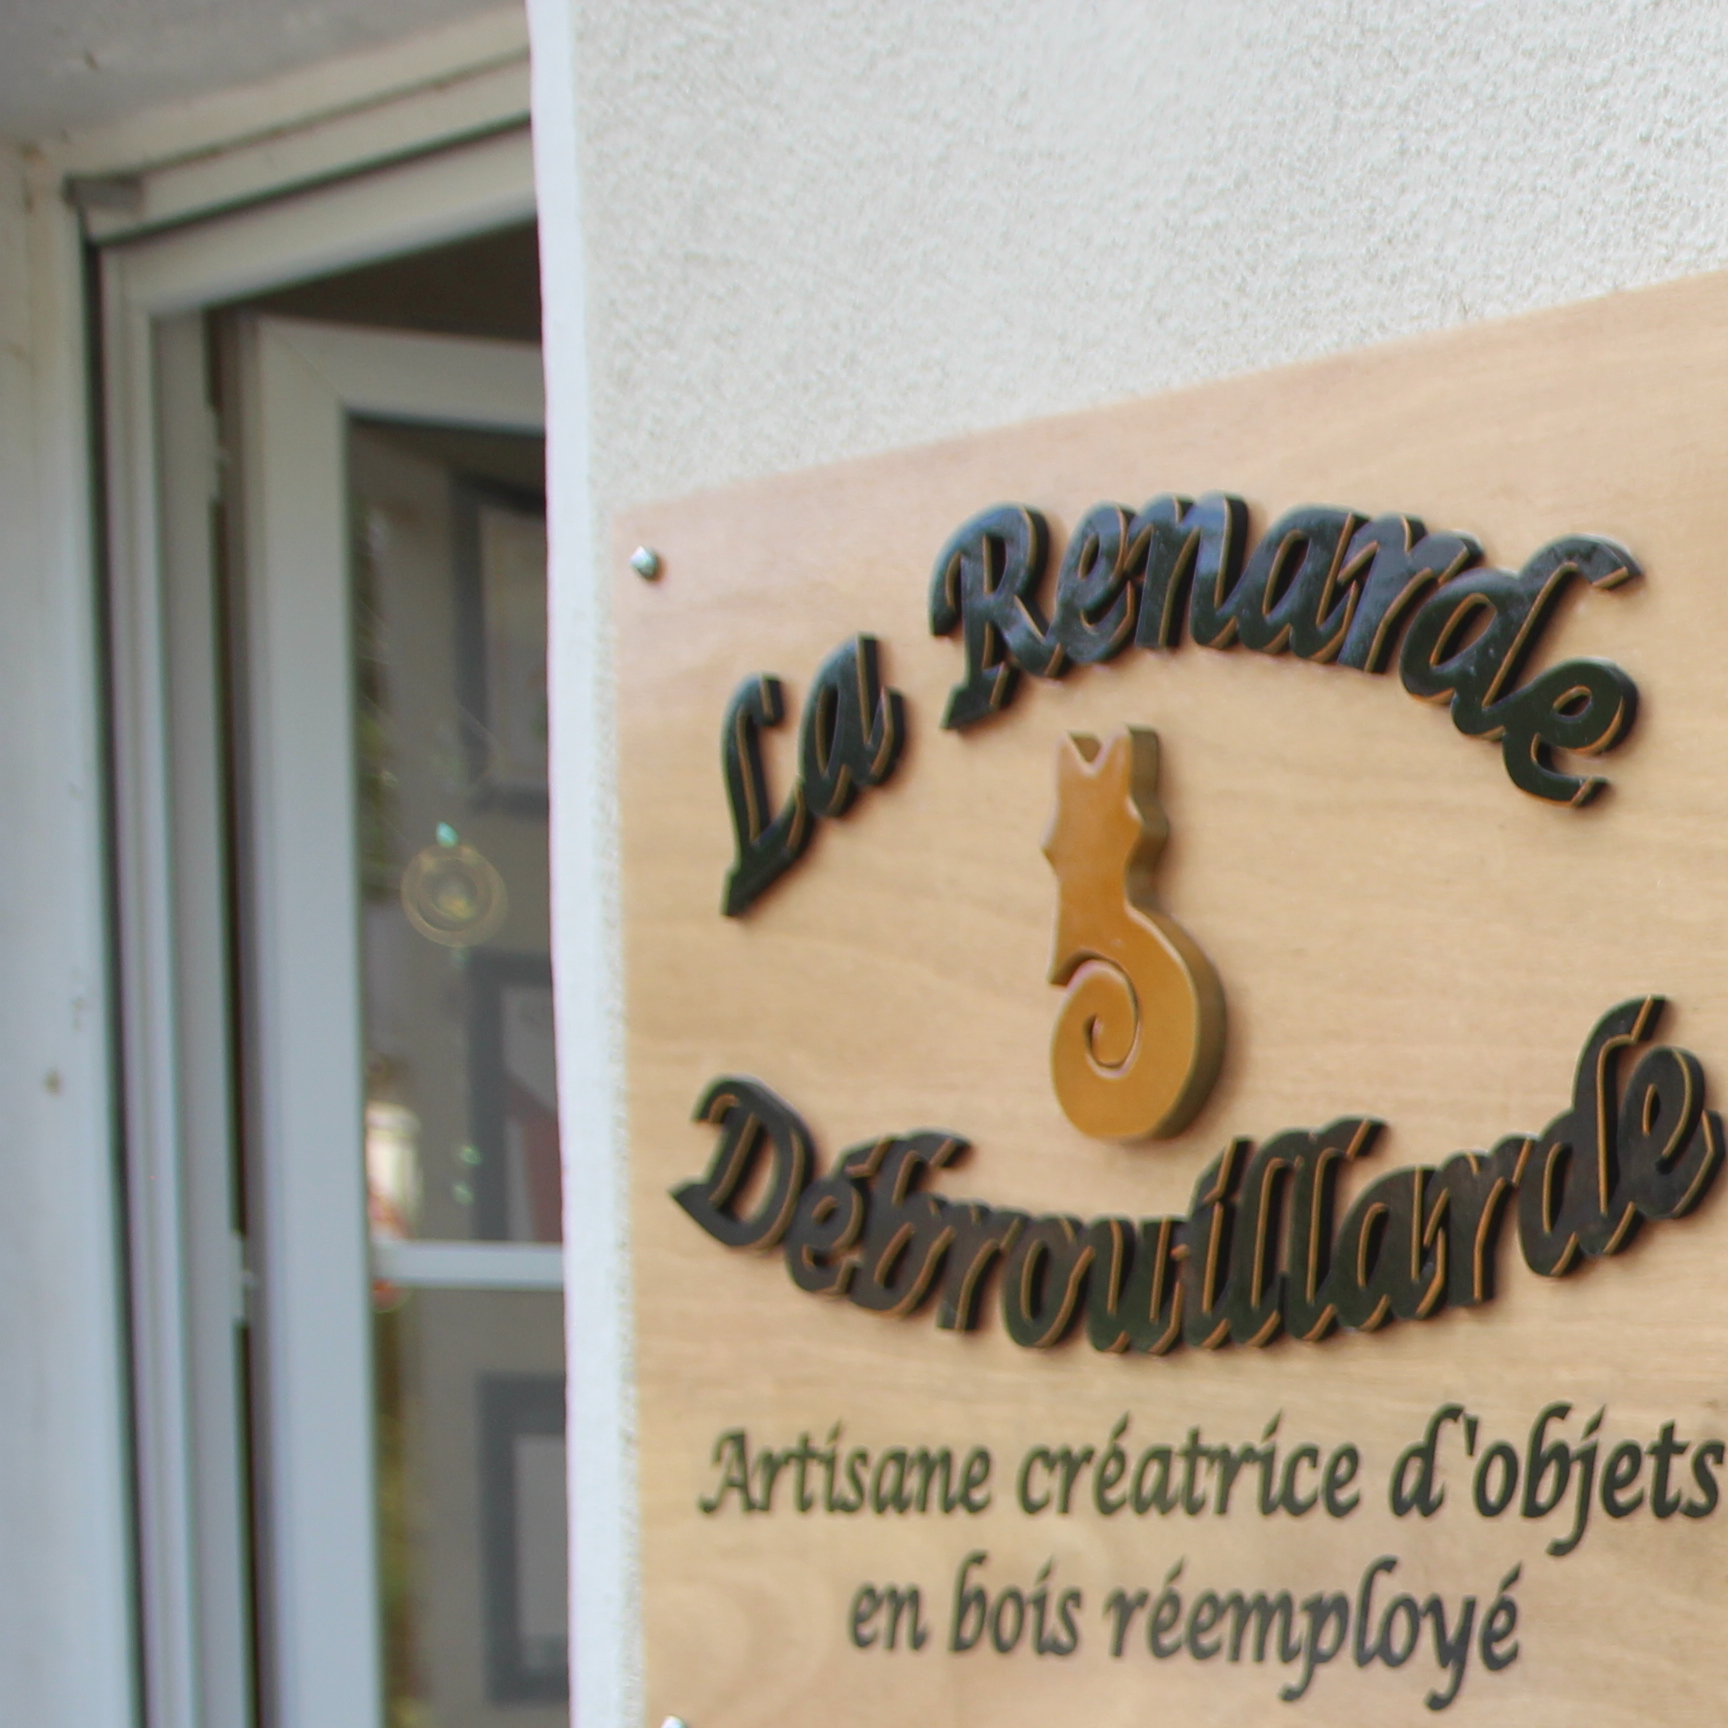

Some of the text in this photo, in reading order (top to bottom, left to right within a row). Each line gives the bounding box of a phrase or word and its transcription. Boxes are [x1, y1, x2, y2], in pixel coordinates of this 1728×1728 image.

[719, 491, 1647, 919] La Renarde
[698, 1403, 1728, 1557] Artisane créatrice d'objets
[848, 1550, 1523, 1712] en bois réemployé
